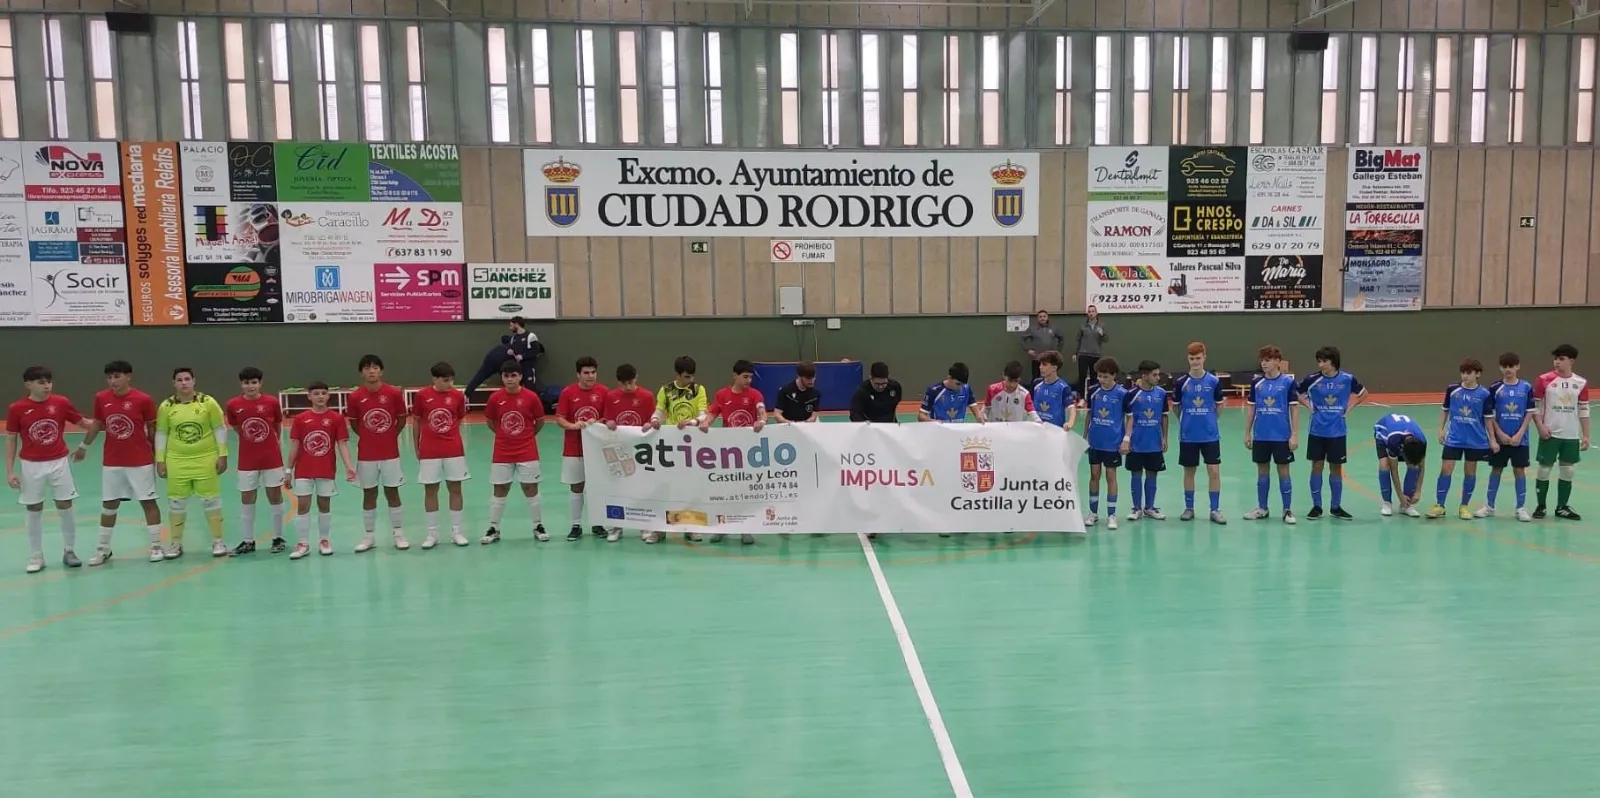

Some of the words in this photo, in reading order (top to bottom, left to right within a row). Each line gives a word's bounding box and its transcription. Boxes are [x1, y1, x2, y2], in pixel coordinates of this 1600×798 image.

[184, 146, 224, 154] PALACIO
[369, 144, 417, 160] TEXTILES
[420, 144, 459, 160] ACOSTA
[51, 160, 104, 171] NOVA
[1355, 149, 1421, 172] BigMat
[617, 157, 722, 186] Excmo.
[729, 159, 915, 192] Ayuntamiento
[922, 159, 954, 187] de
[1352, 172, 1385, 181] Gallego
[1388, 172, 1423, 180] Esteban
[598, 193, 769, 228] CIUDAD
[778, 194, 974, 228] RODRIGO
[1196, 206, 1236, 218] HNOS.
[157, 193, 178, 253] Inmobiliaria
[317, 216, 369, 227] Caracillo
[1262, 216, 1274, 228] DA
[1283, 215, 1296, 228] SIL
[1349, 212, 1361, 224] LA
[1364, 210, 1420, 225] TORRECILLA
[1103, 225, 1153, 237] RAMON
[1196, 219, 1243, 231] CRESPO
[1251, 242, 1271, 250] 629
[1274, 242, 1287, 250] 07
[1291, 242, 1304, 250] 20
[135, 227, 152, 279] solyges
[395, 249, 412, 257] 637
[414, 249, 425, 257] 83
[428, 249, 438, 257] 11
[440, 249, 452, 257] 90
[1169, 262, 1196, 271] Talleres
[1198, 262, 1223, 271] Pascual
[1225, 261, 1241, 271] Silva
[66, 273, 120, 288] Sacir
[141, 282, 153, 322] SEGUROS
[285, 291, 373, 304] MIROBRIGAWAGEN
[1098, 294, 1118, 303] 923
[1121, 294, 1141, 303] 250
[1143, 294, 1162, 302] 971
[1253, 300, 1271, 309] 923
[1276, 299, 1294, 309] 462
[1298, 299, 1316, 308] 251
[634, 434, 797, 472] atiendo
[840, 453, 876, 466] NOS
[708, 472, 753, 482] Castilla
[756, 472, 763, 483] y
[767, 468, 798, 479] León
[840, 469, 935, 490] IMPULSA
[999, 478, 1048, 492] Junta
[1054, 477, 1072, 491] de
[709, 492, 798, 501] www.atiendojcyl.es
[951, 496, 1012, 511] Castilla
[1017, 499, 1028, 513] y
[1033, 495, 1075, 510] León
